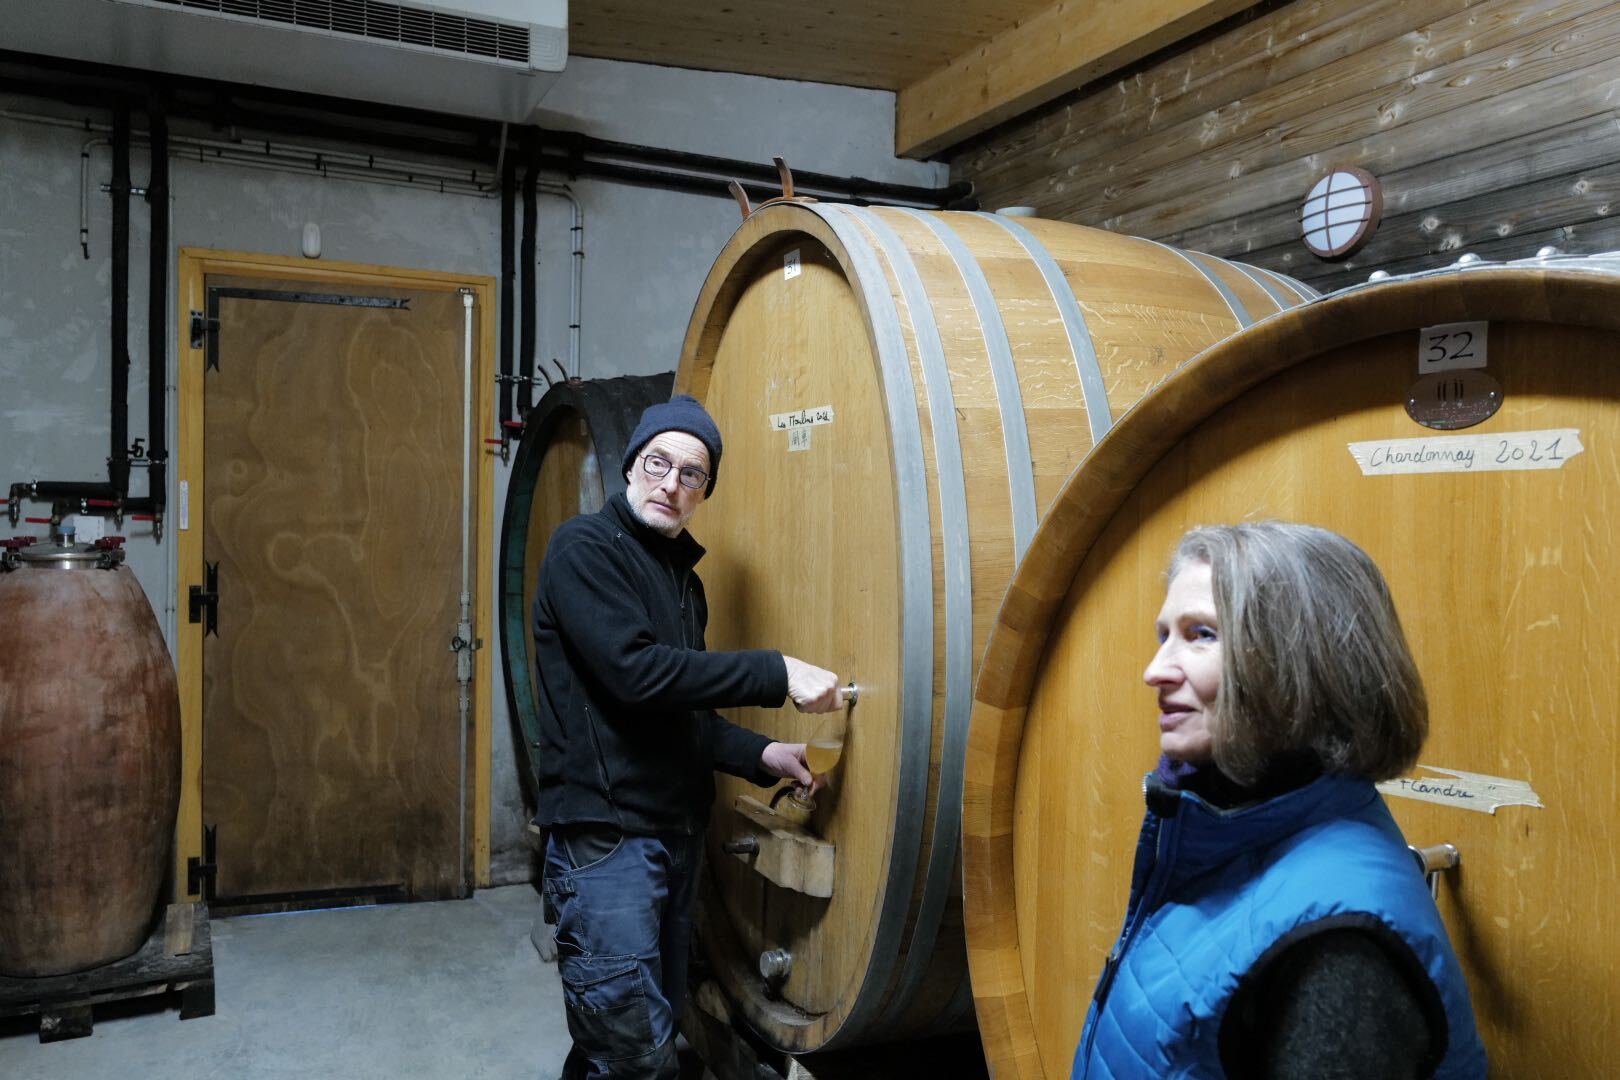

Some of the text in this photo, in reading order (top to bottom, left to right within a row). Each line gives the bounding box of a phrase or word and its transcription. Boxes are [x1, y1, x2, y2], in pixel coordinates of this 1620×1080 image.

[1426, 331, 1474, 362] 32
[1369, 437, 1564, 468] Chardonnay 2021
